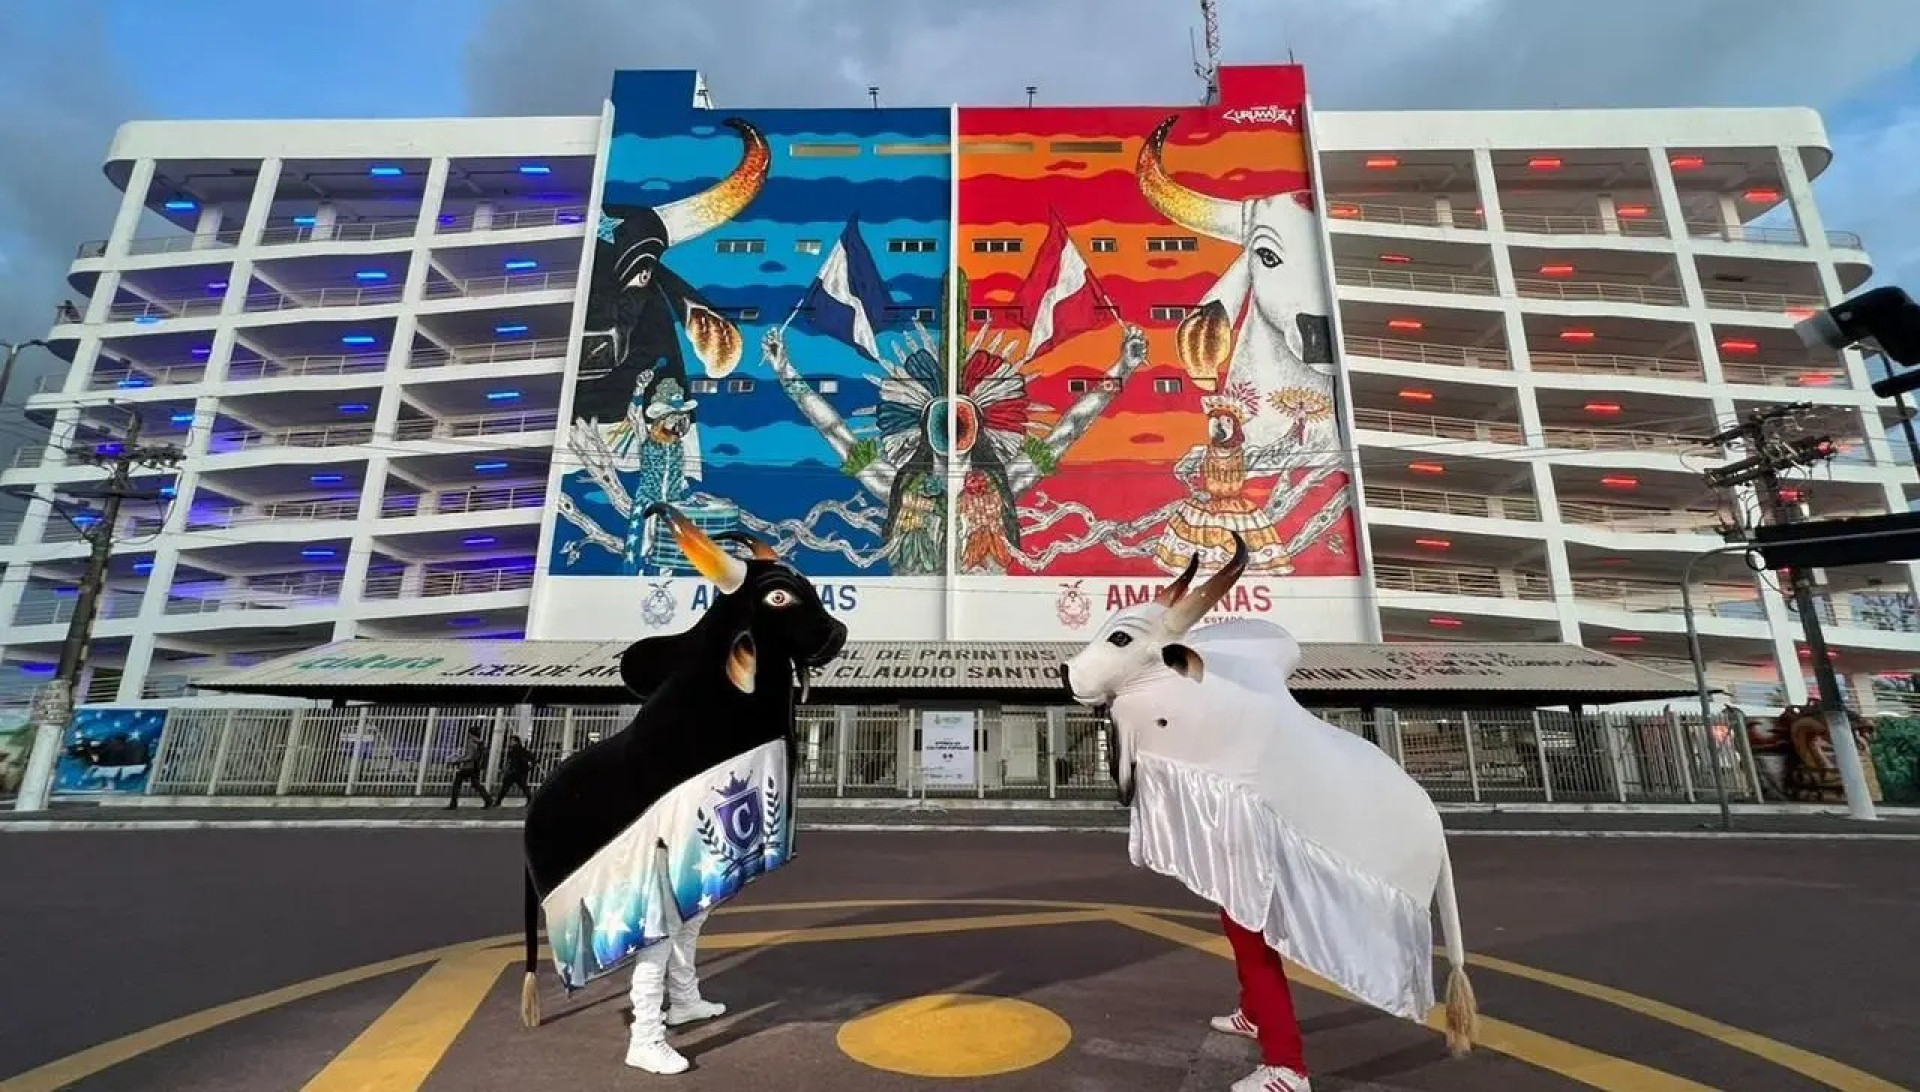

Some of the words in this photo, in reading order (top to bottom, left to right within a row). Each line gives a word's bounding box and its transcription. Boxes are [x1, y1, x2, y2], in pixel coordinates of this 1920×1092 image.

[1106, 584, 1272, 612] AMNAS
[920, 650, 1057, 660] PARINTINS
[834, 666, 956, 678] CLAUDIO
[967, 666, 1061, 678] SANTO
[1286, 668, 1416, 680] ARINTINS
[731, 801, 754, 839] C
